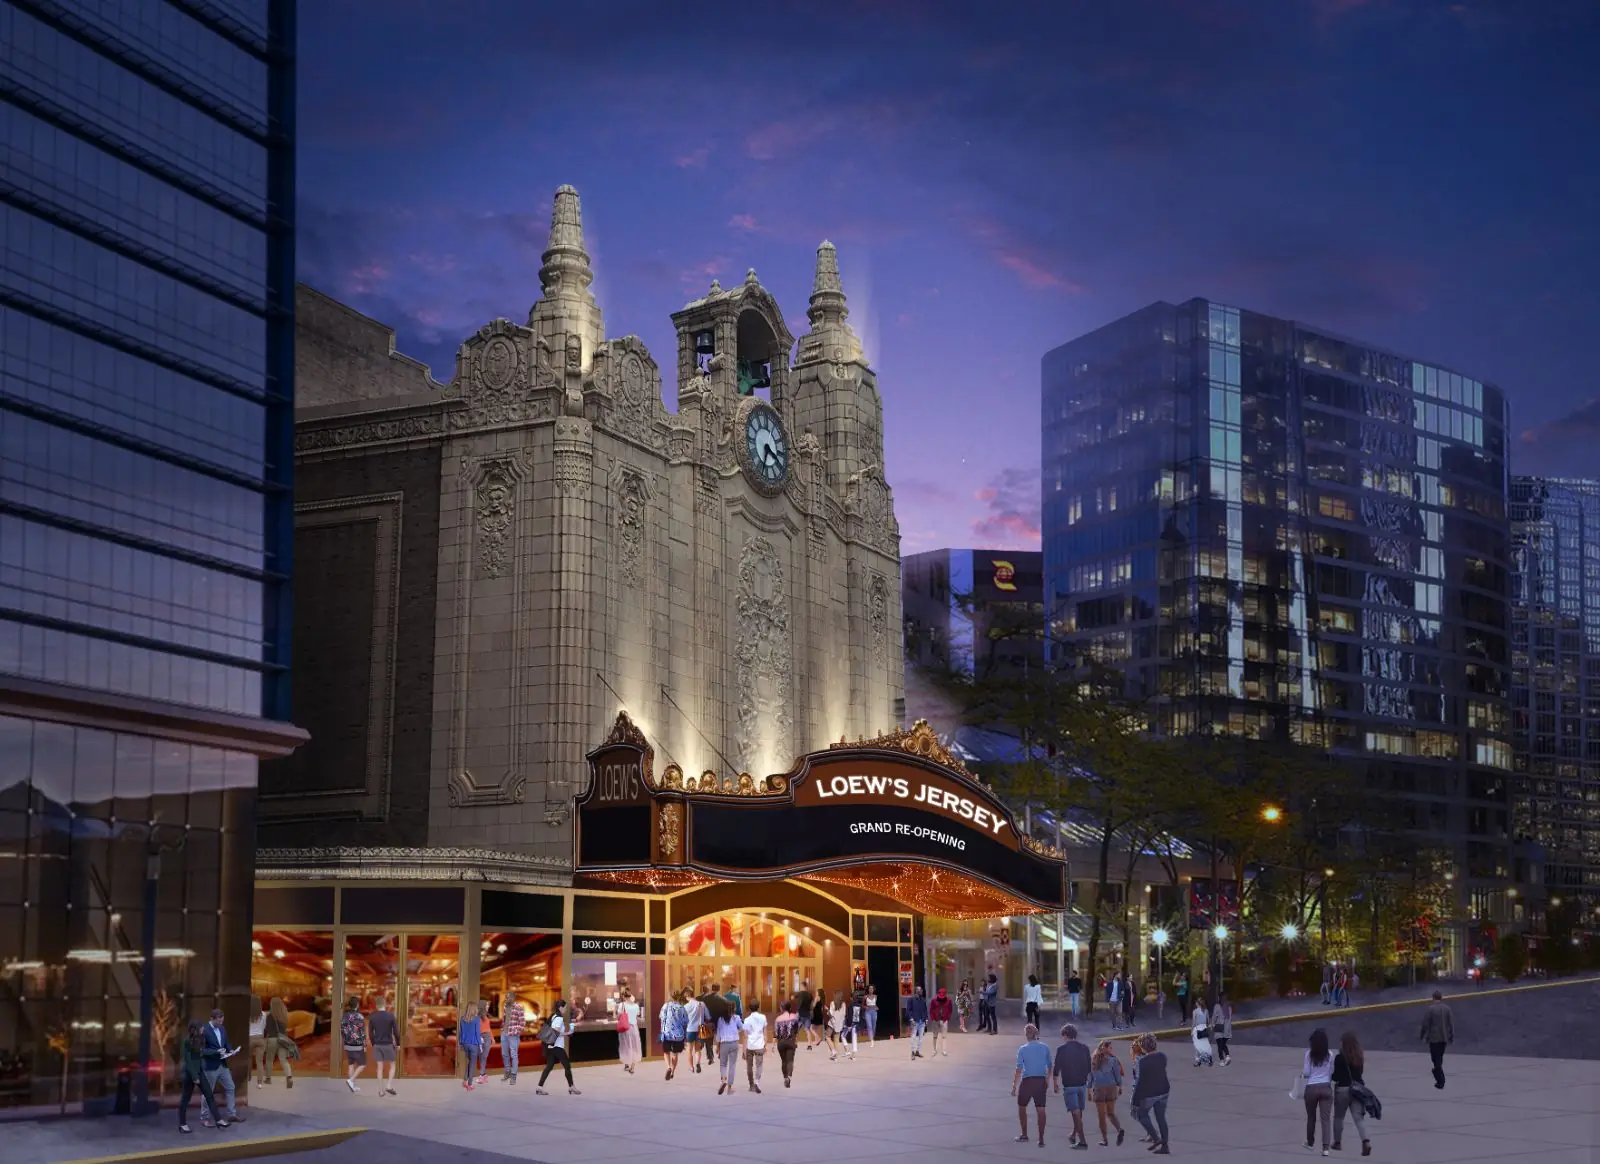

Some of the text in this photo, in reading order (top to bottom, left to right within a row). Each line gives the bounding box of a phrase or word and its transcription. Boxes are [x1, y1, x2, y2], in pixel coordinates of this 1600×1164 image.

[816, 776, 1007, 834] LOEW'S JERSEY
[850, 822, 966, 850] GRAND RE-OPENING
[581, 940, 637, 950] BOX OFFICE
